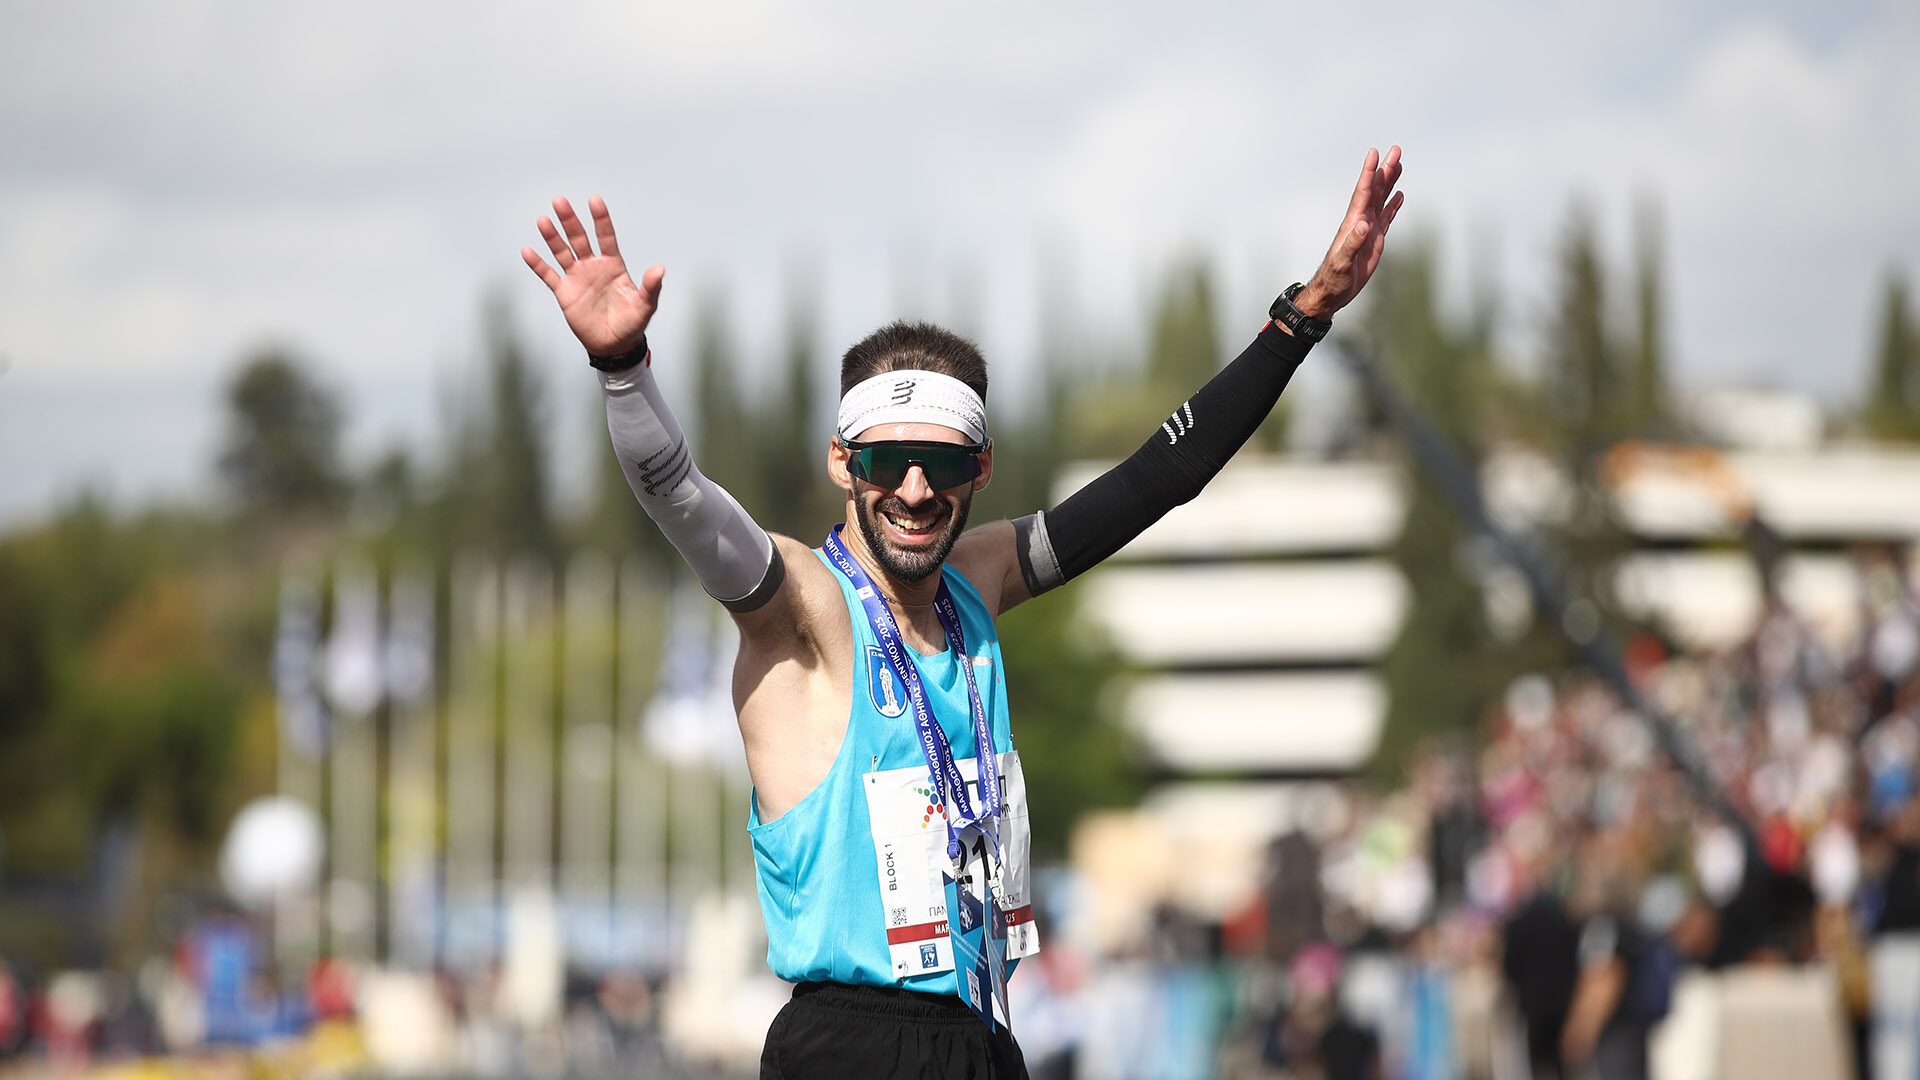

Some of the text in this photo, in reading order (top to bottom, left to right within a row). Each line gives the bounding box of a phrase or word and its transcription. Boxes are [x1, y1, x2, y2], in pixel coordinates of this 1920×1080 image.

[838, 557, 857, 577] 2025
[875, 617, 891, 639] 2025
[922, 728, 945, 796] ΜΑΡΑΘΩΝΙΟΣ
[983, 741, 998, 808] ΜΑΡΑΘΩΝΙΟΣ
[885, 852, 897, 891] BLOCK
[929, 905, 947, 917] ΠΑΝ
[934, 924, 949, 935] ΜΑΡ
